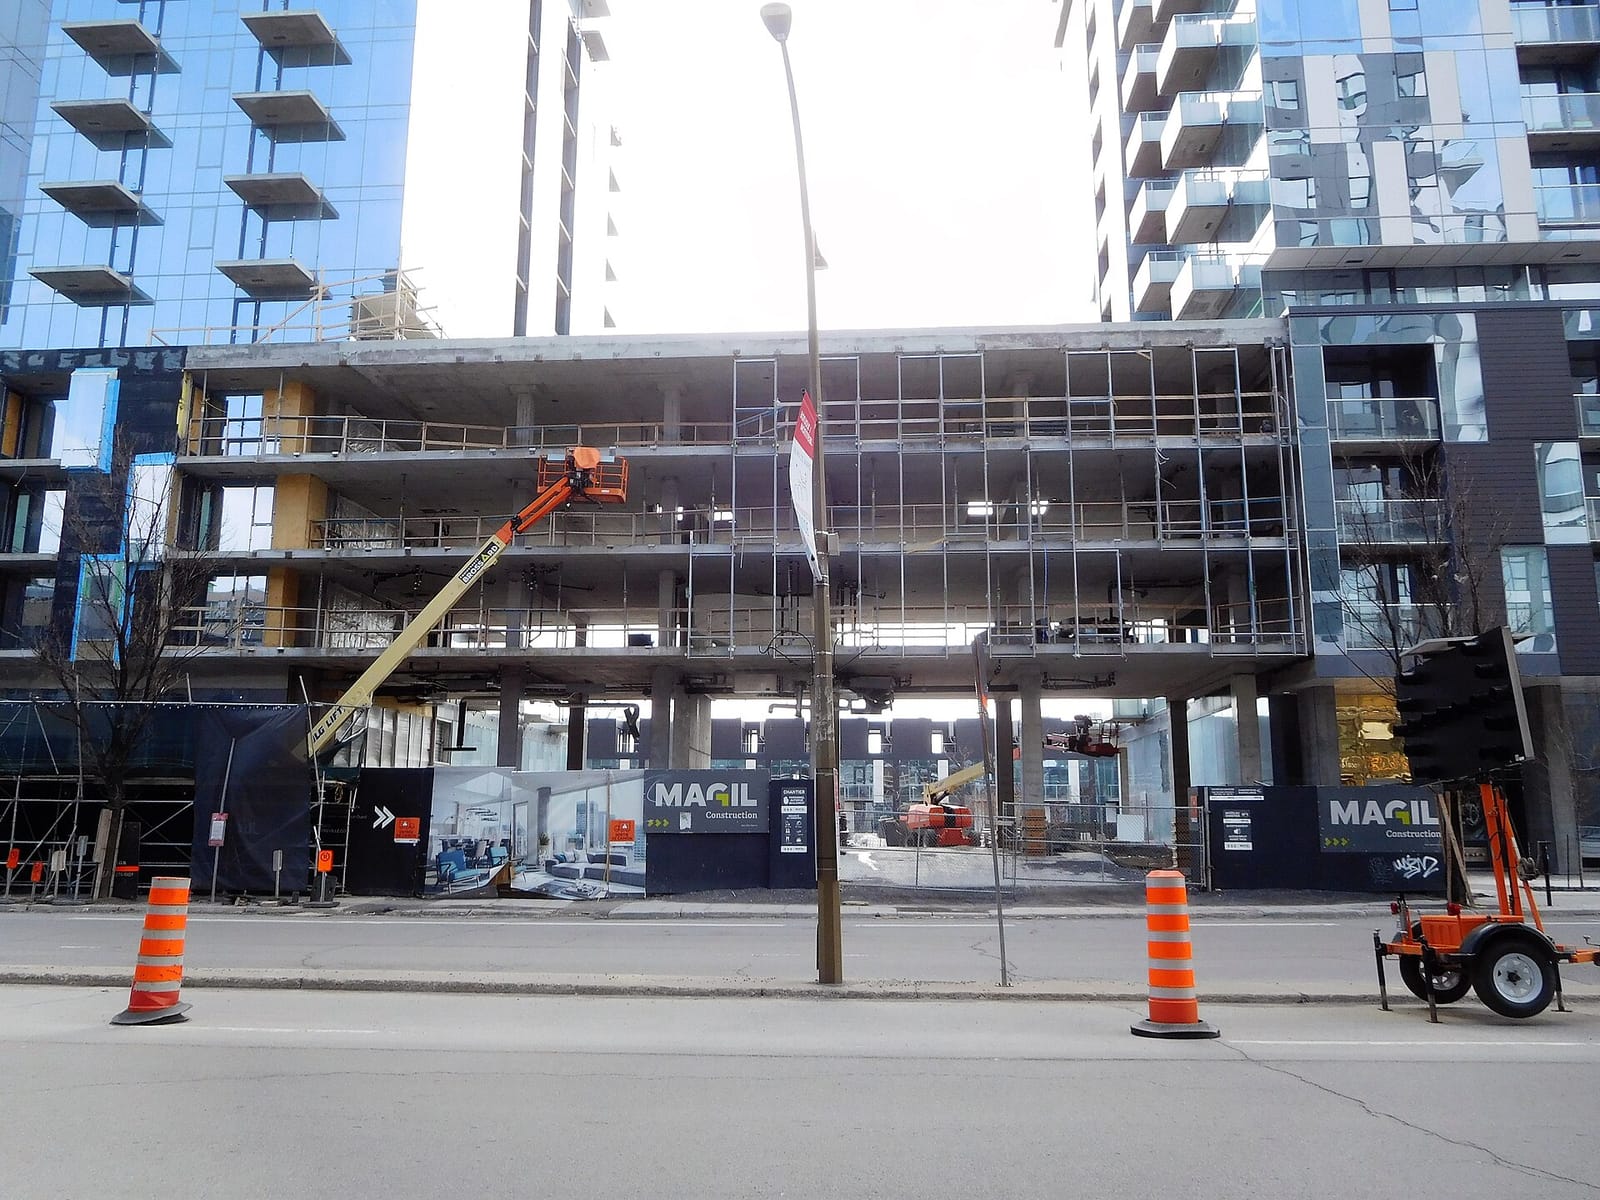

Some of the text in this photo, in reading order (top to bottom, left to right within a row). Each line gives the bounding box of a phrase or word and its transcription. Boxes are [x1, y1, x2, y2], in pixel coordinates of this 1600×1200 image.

[655, 782, 758, 807] MAGIL
[705, 810, 758, 820] Construction
[1329, 799, 1440, 826] MAGIL
[1385, 829, 1442, 839] Construction
